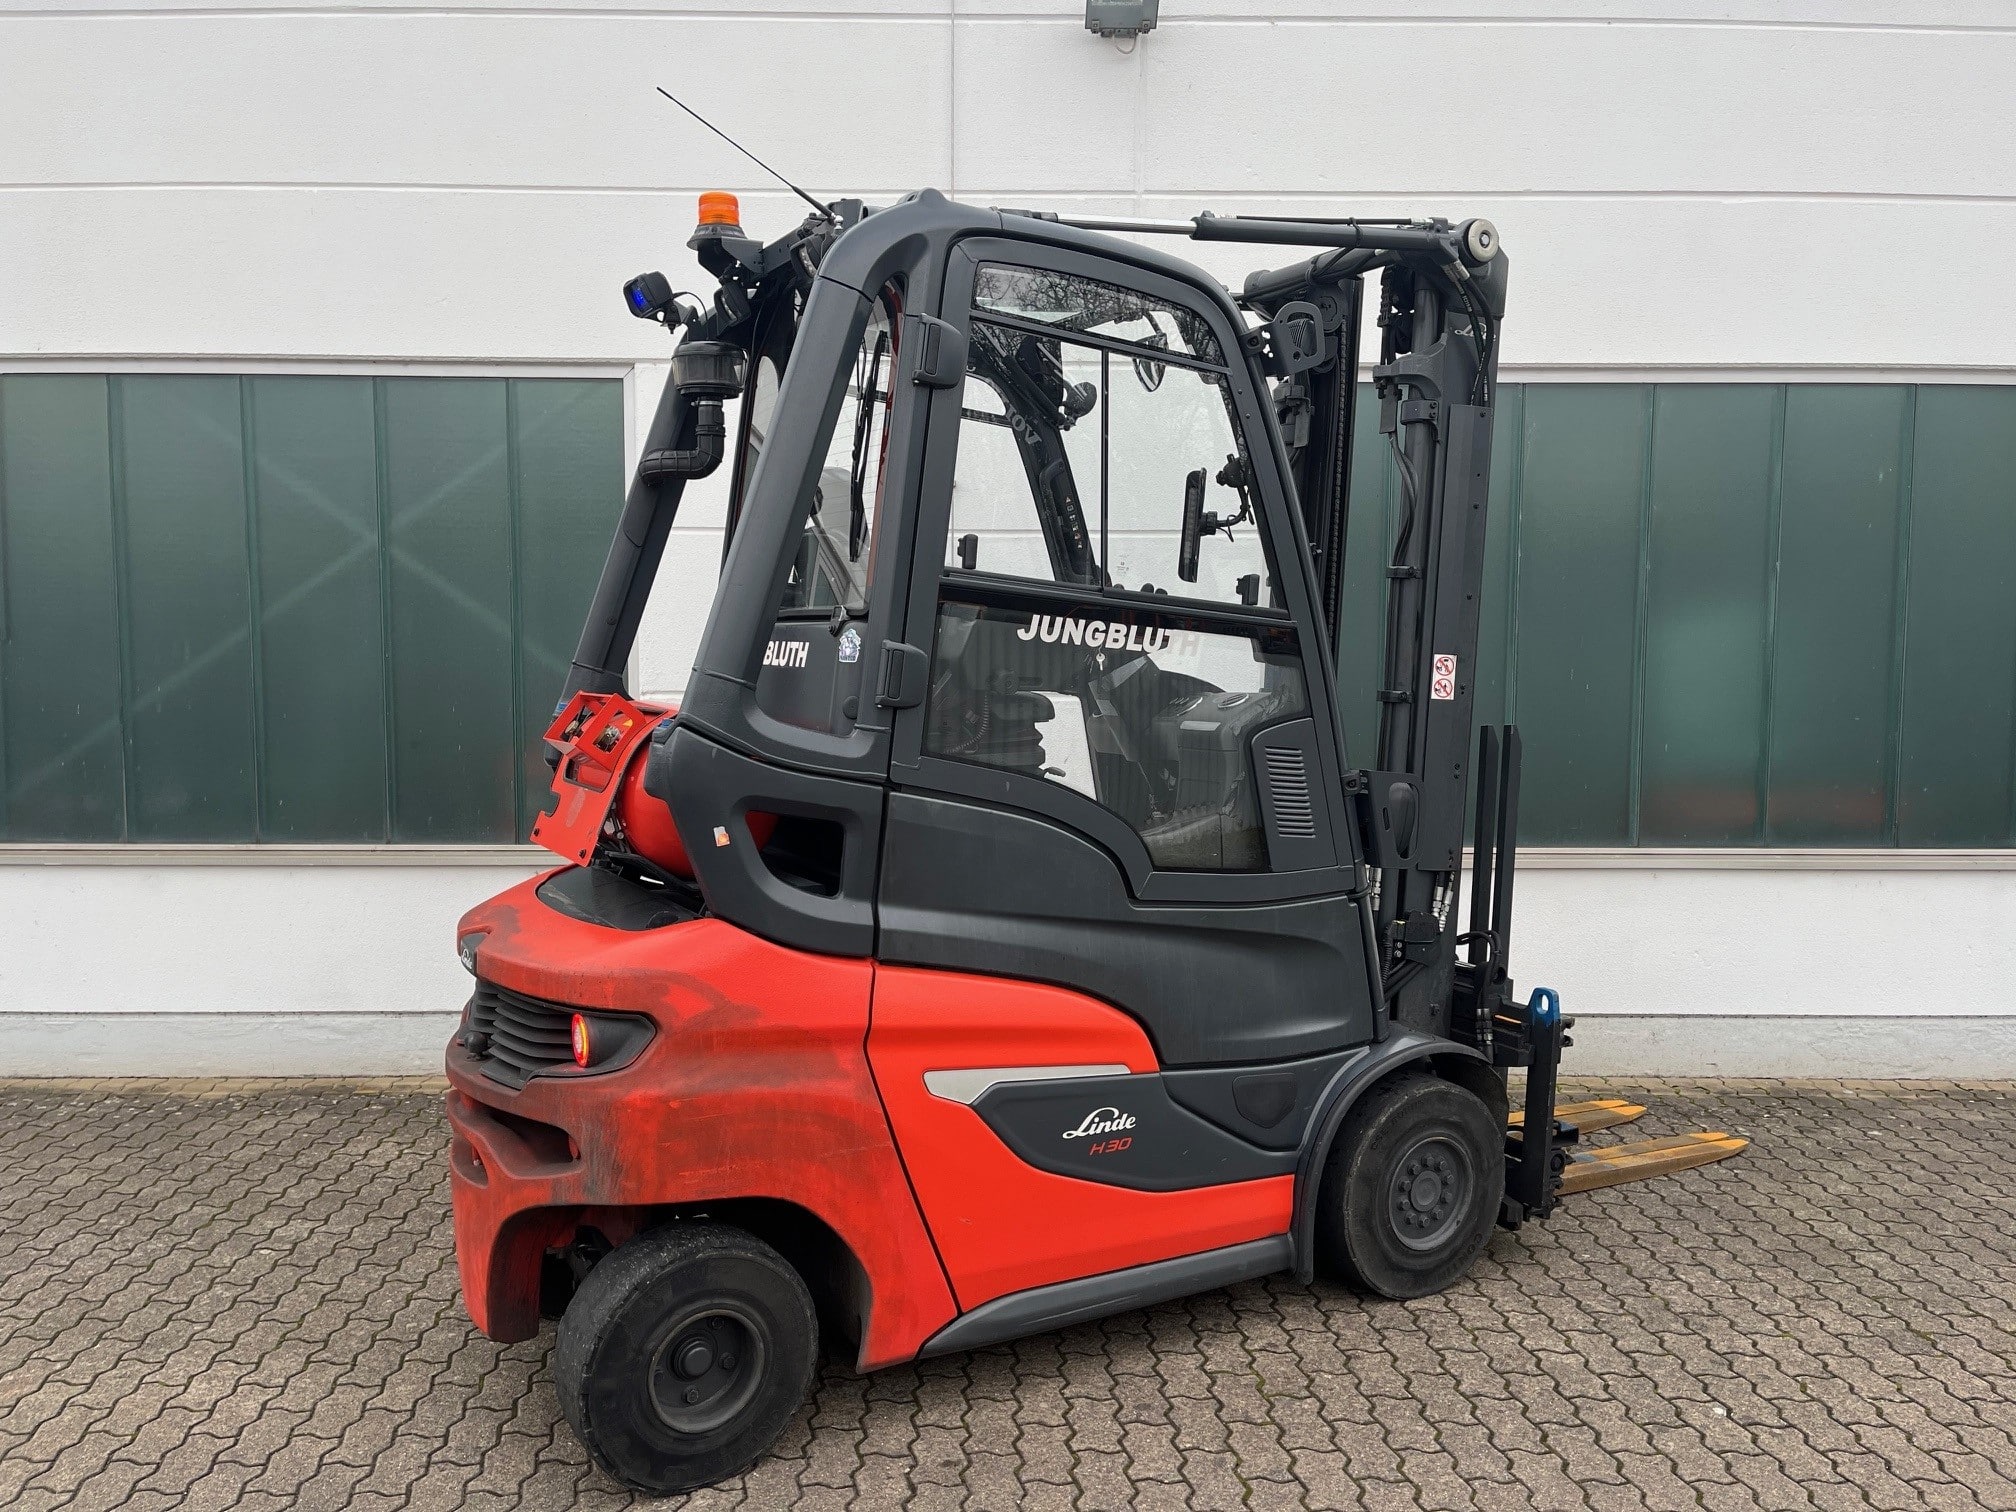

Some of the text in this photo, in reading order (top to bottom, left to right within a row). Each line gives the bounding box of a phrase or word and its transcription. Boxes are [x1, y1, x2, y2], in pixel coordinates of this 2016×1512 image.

[1016, 614, 1200, 656] JUNGBLUTH
[762, 640, 810, 668] BLUTH
[1062, 1107, 1136, 1139] Linde
[1089, 1137, 1132, 1156] H30
